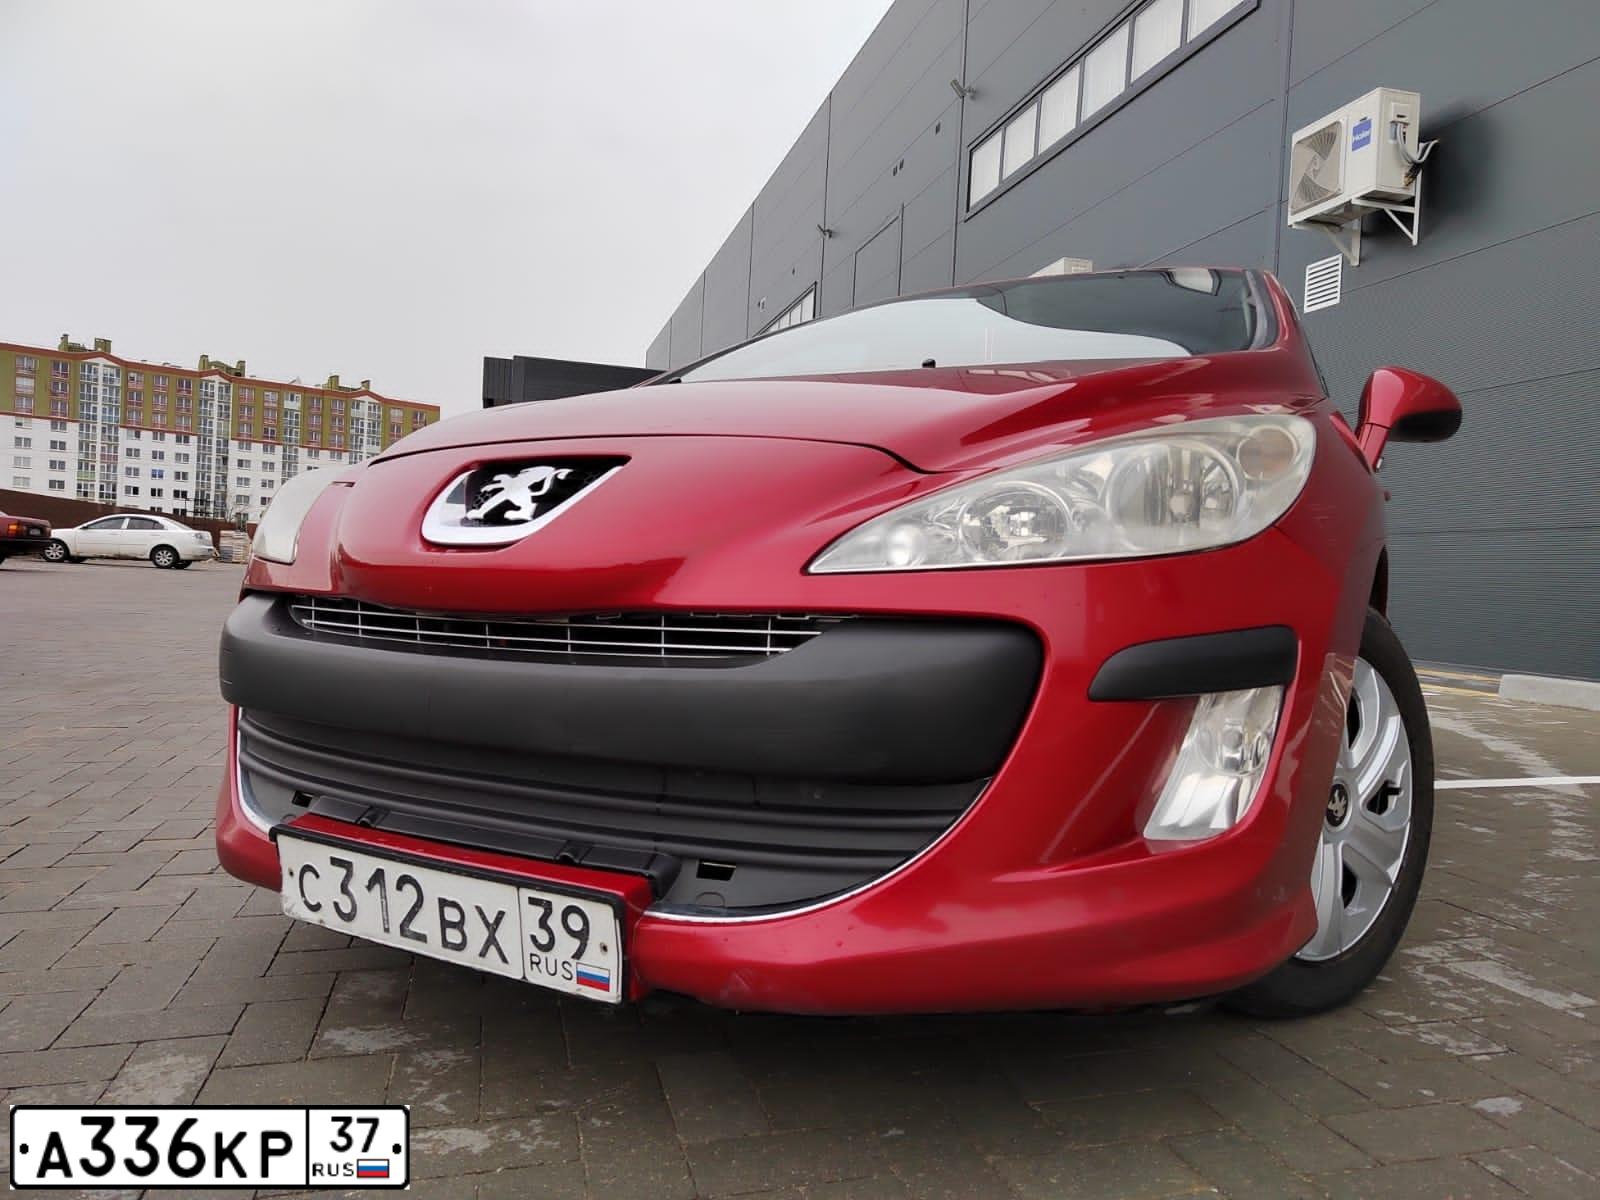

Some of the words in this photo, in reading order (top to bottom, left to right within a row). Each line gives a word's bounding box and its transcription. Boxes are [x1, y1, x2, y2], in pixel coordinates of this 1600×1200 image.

[299, 856, 509, 964] С312ВХ
[528, 896, 591, 960] 39
[529, 953, 573, 981] RUS
